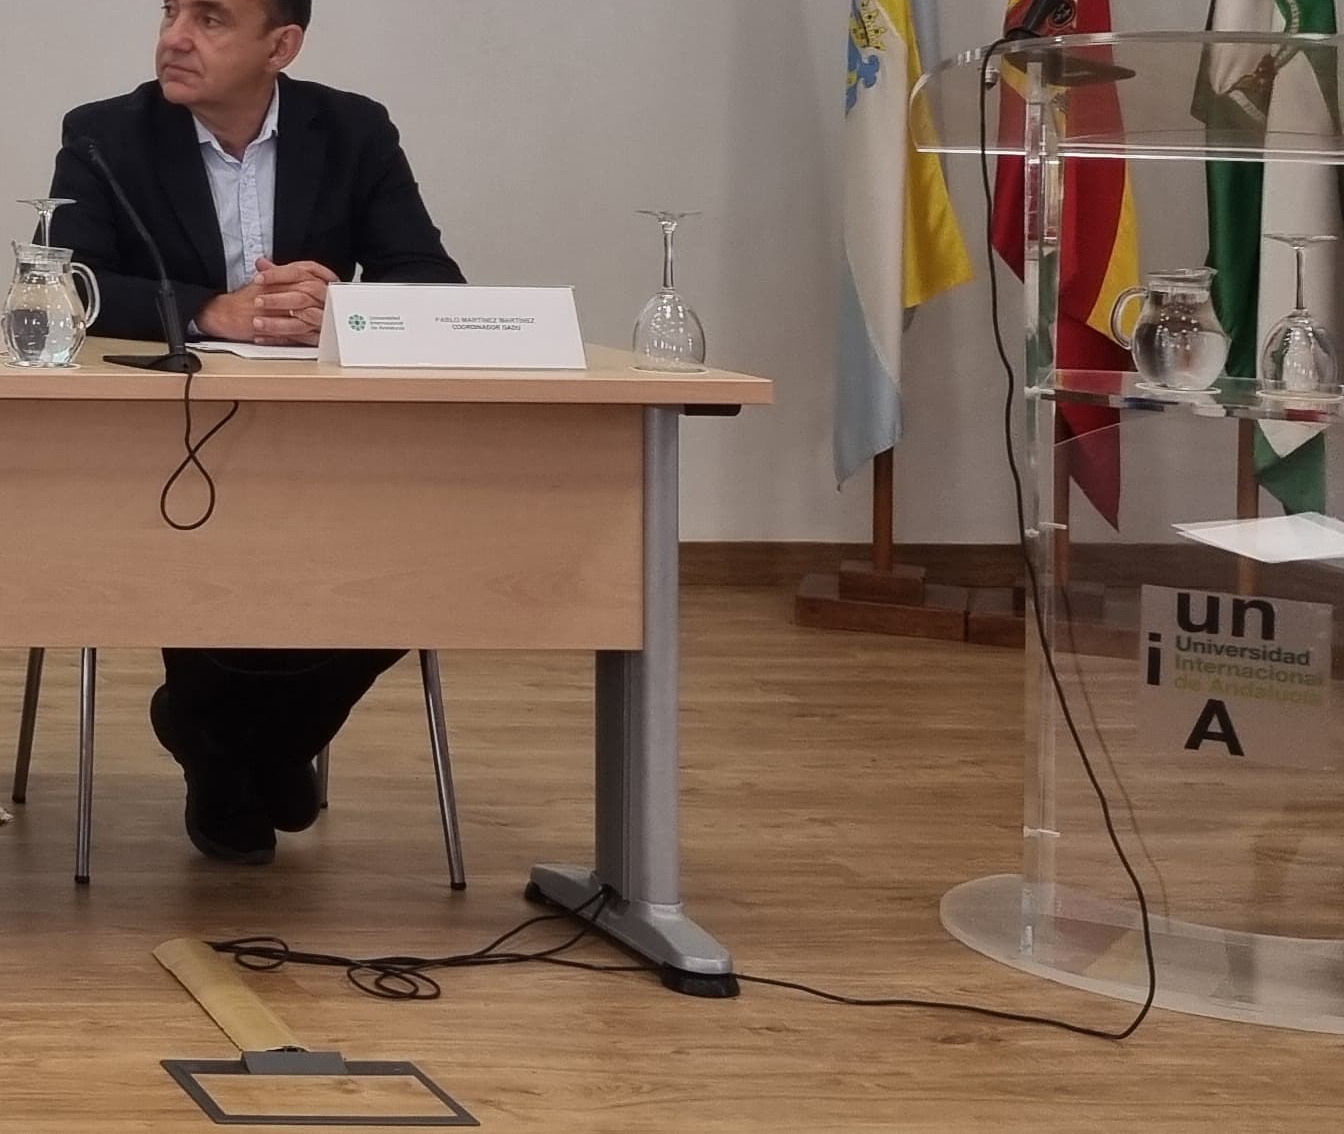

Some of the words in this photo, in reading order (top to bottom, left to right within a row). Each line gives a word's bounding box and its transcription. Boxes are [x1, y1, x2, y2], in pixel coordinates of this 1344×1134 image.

[1176, 592, 1276, 641] un
[1174, 654, 1323, 686] Internacional
[1175, 635, 1311, 667] Universidad
[1184, 698, 1244, 756] A
